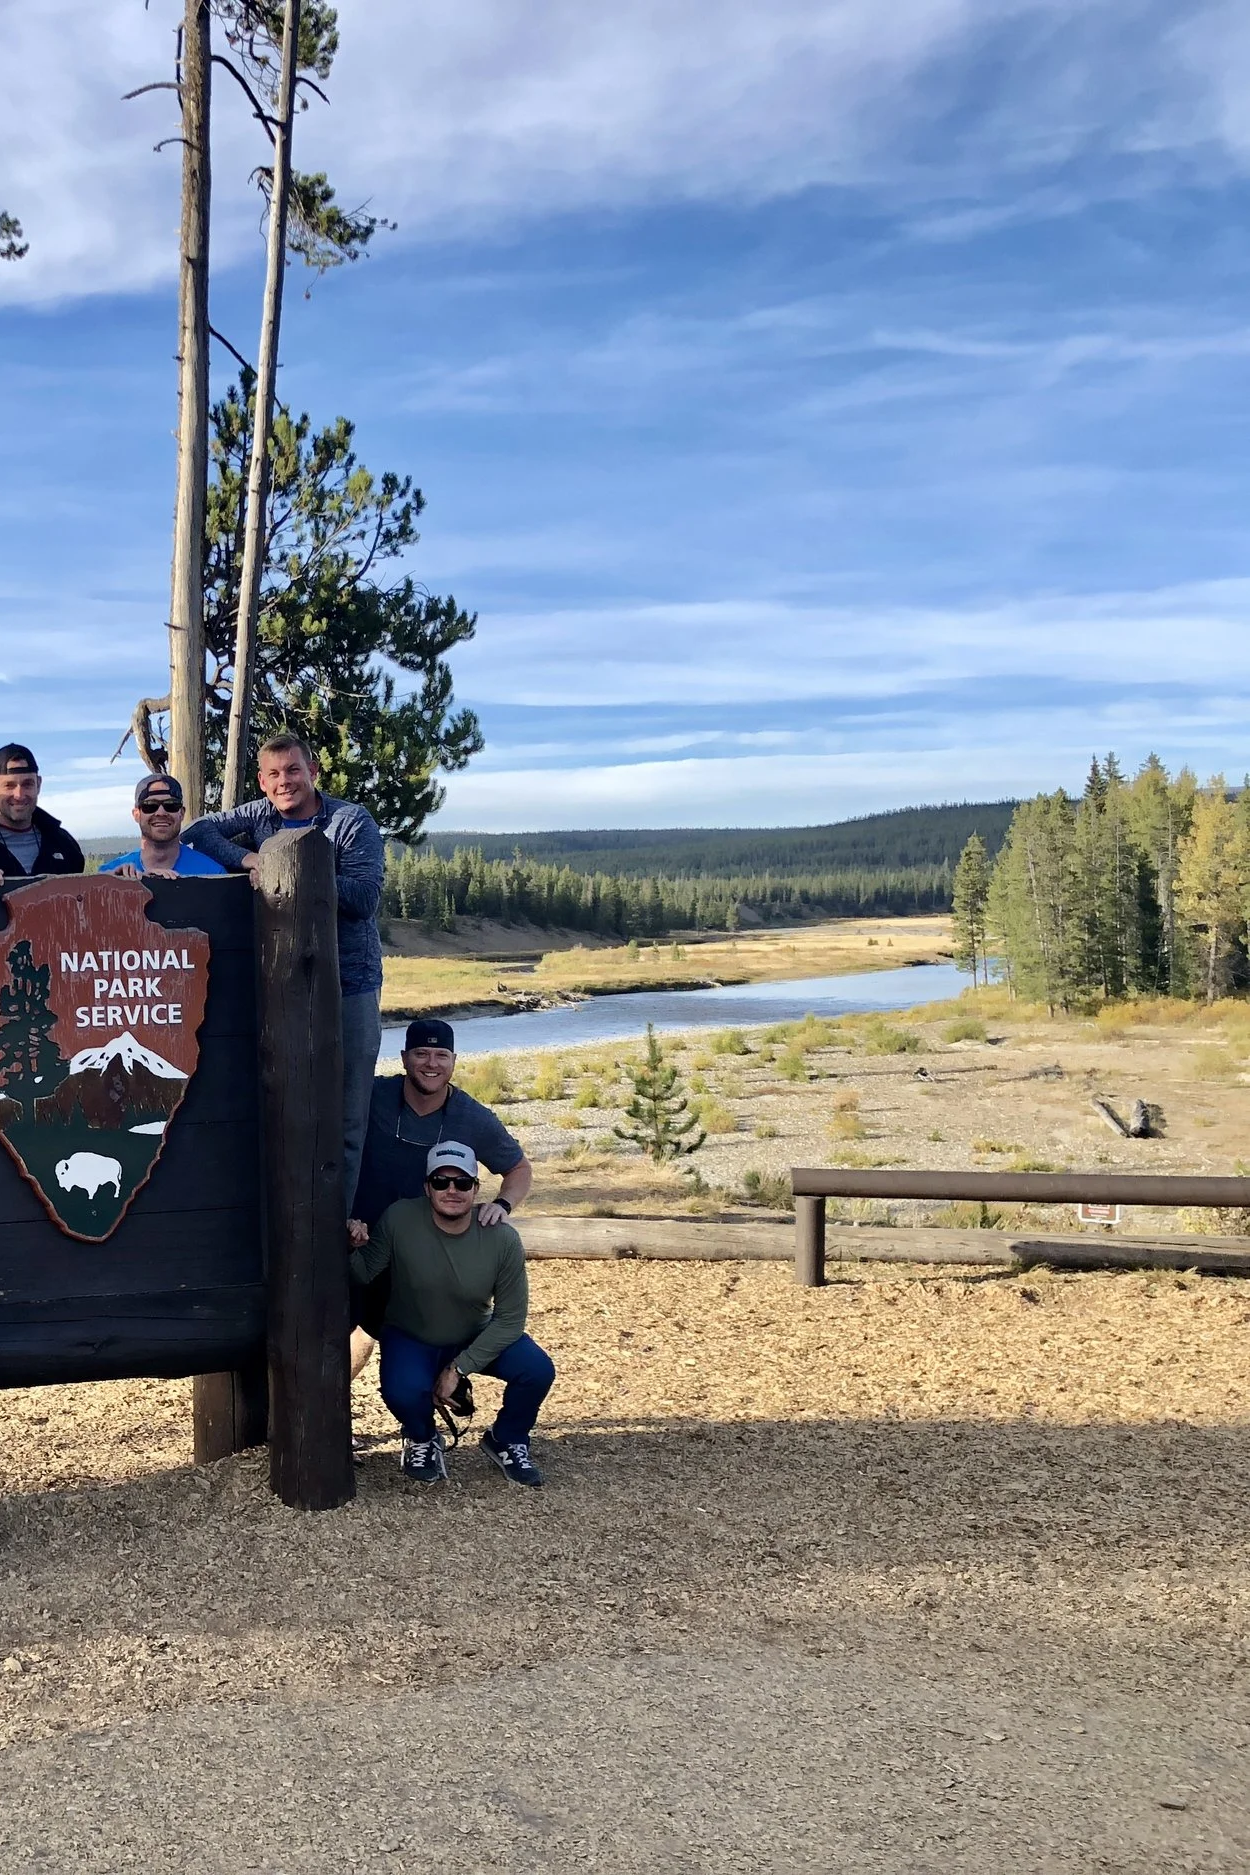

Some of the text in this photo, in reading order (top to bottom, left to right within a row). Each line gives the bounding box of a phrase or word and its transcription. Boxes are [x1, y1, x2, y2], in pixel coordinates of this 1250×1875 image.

[60, 949, 195, 972] NATIONAL
[94, 977, 162, 999] PARK
[75, 1003, 182, 1028] SERVICE
